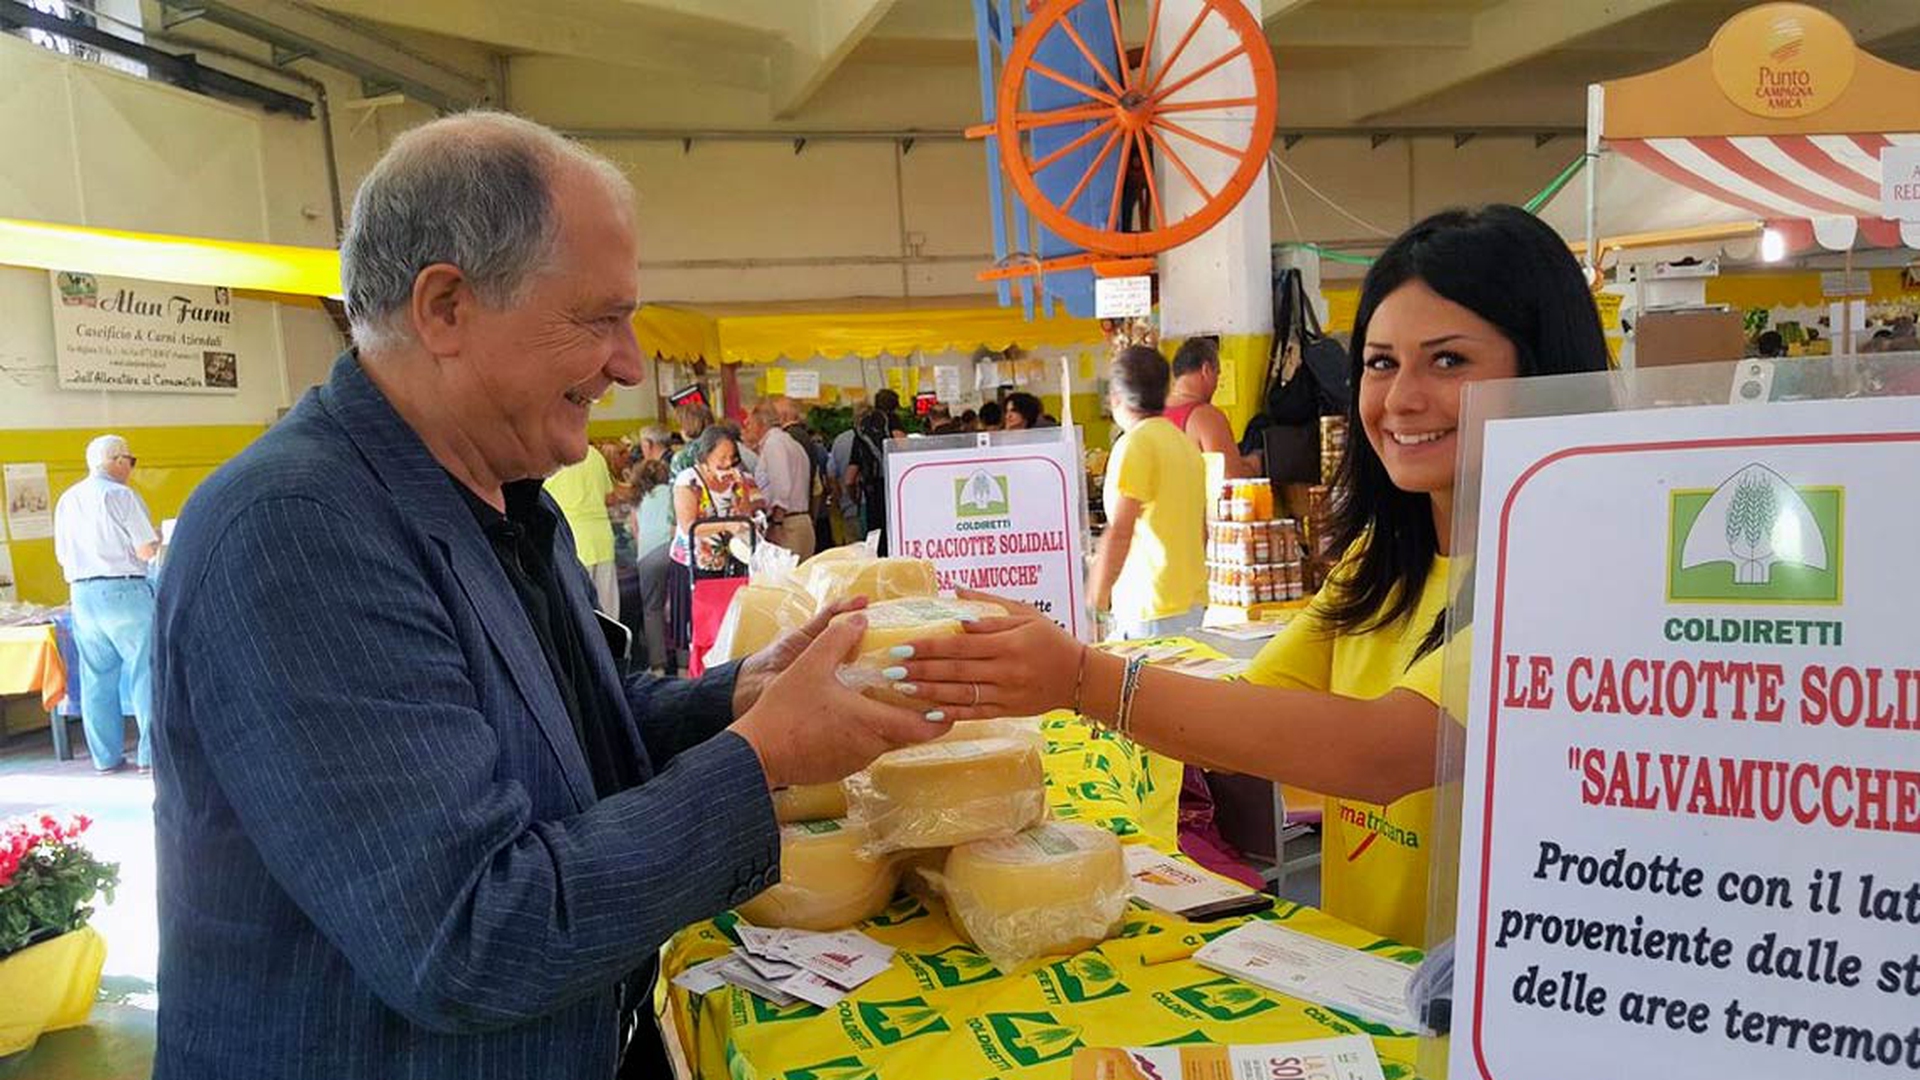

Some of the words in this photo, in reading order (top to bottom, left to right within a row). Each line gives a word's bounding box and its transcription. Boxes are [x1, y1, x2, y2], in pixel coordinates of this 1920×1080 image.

[1759, 66, 1810, 87] Punto
[1755, 86, 1814, 98] CAMPAGNA
[1768, 98, 1803, 109] AMICA
[100, 289, 163, 318] Alan
[168, 295, 231, 325] Farm
[76, 323, 132, 342] Caseificio
[134, 331, 143, 340] &
[147, 331, 177, 343] Carni
[178, 334, 223, 347] Aziendali
[956, 519, 1011, 531] COLDIRETTI
[904, 540, 923, 560] LE
[926, 535, 996, 559] CACIOTTE
[999, 531, 1064, 555] SOLIDALI
[1664, 617, 1843, 646] COLDIRETTI
[1503, 655, 1554, 710] LE
[1566, 657, 1785, 723] CACIOTTE
[1534, 841, 1705, 898] Prodotte
[1717, 870, 1793, 909] con
[1808, 868, 1844, 915] il
[1858, 873, 1920, 925] lat
[1495, 907, 1733, 969] proveniente
[1746, 932, 1863, 987] dalle
[1512, 965, 1607, 1016] delle
[1618, 991, 1711, 1034] aree
[1724, 999, 1920, 1070] terremot
[1271, 1057, 1306, 1080] SO
